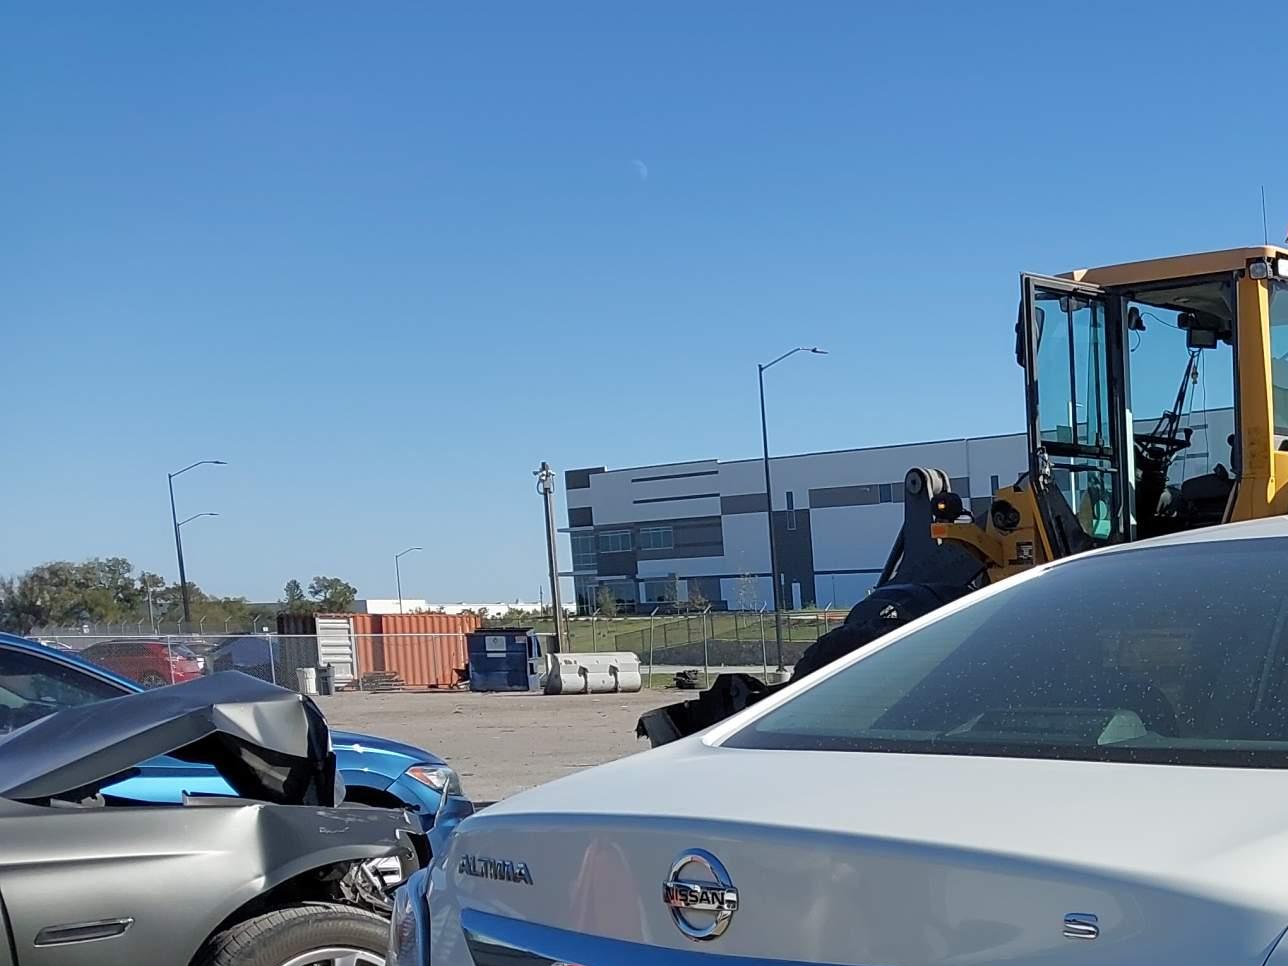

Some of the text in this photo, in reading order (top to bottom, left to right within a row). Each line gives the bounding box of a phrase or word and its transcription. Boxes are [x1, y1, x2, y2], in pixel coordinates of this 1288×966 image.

[458, 854, 533, 885] ALTIMA
[665, 886, 724, 906] NISSAN
[1063, 912, 1099, 940] S
